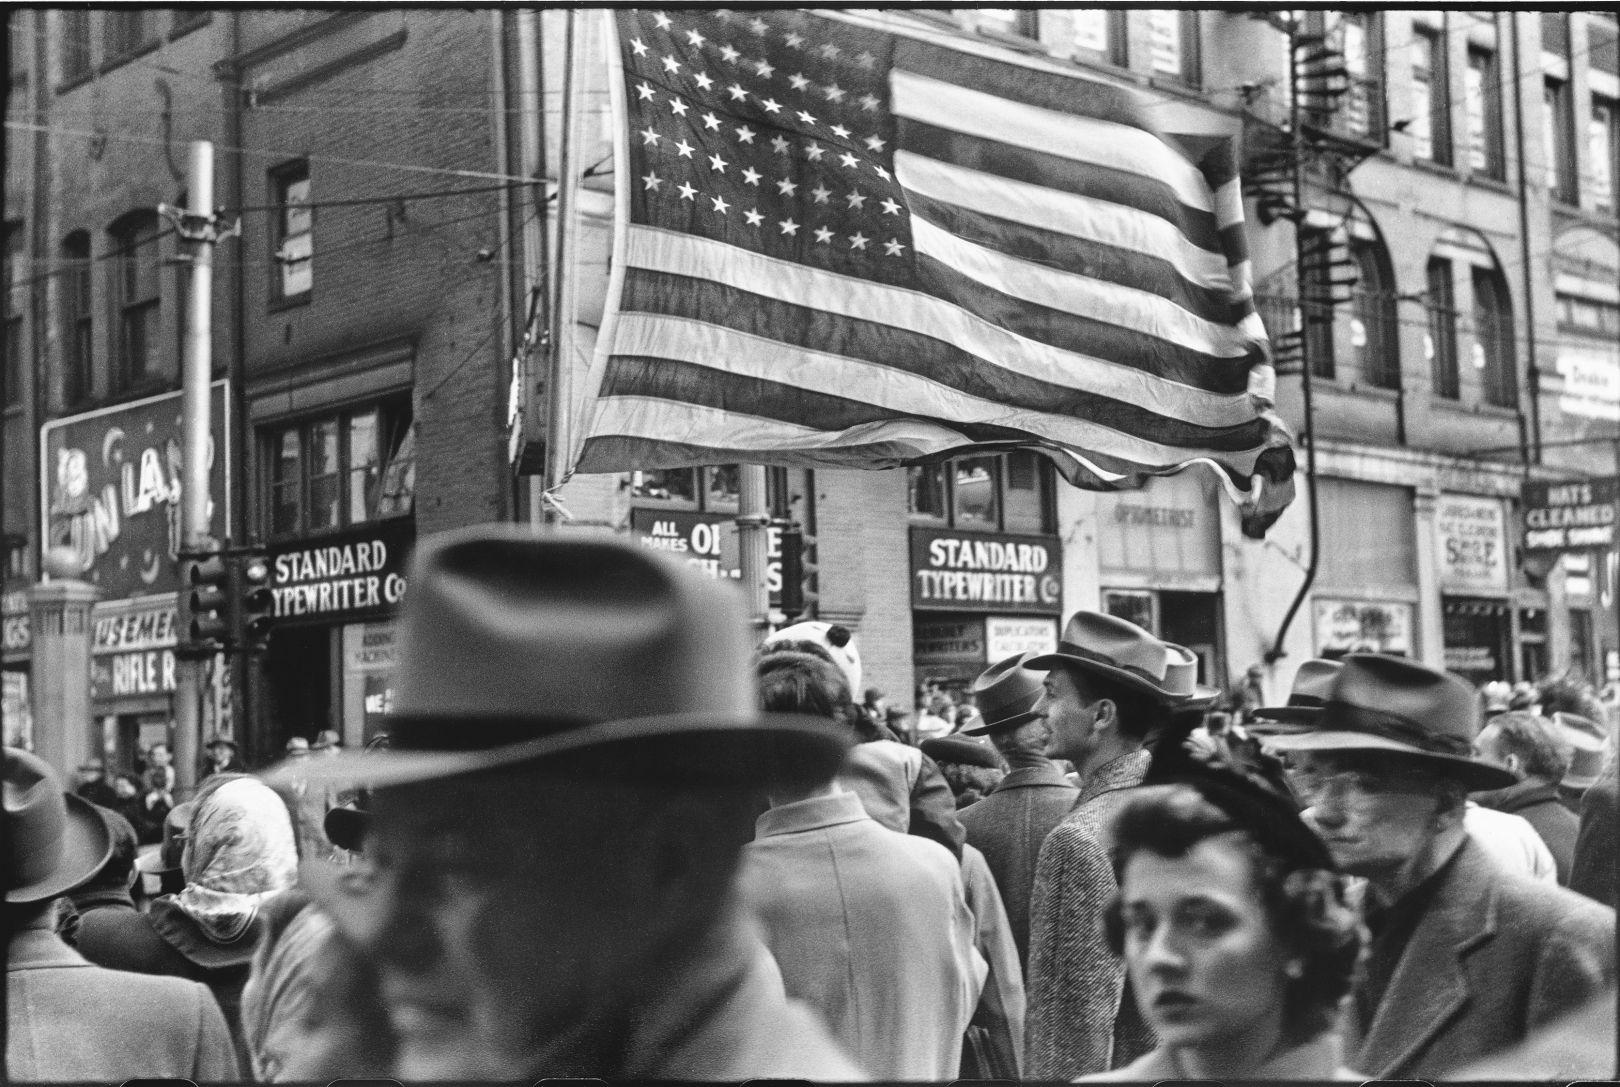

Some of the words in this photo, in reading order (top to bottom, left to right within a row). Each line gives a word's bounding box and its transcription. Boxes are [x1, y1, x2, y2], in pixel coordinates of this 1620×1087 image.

[641, 536, 688, 552] MAKES
[652, 521, 679, 537] ALL
[276, 540, 386, 583] STANDARD
[930, 538, 1048, 573] STANDARD
[271, 576, 380, 617] YPEWRITER
[917, 569, 1037, 602] TYPEWRITER
[113, 651, 157, 694] RIFLE
